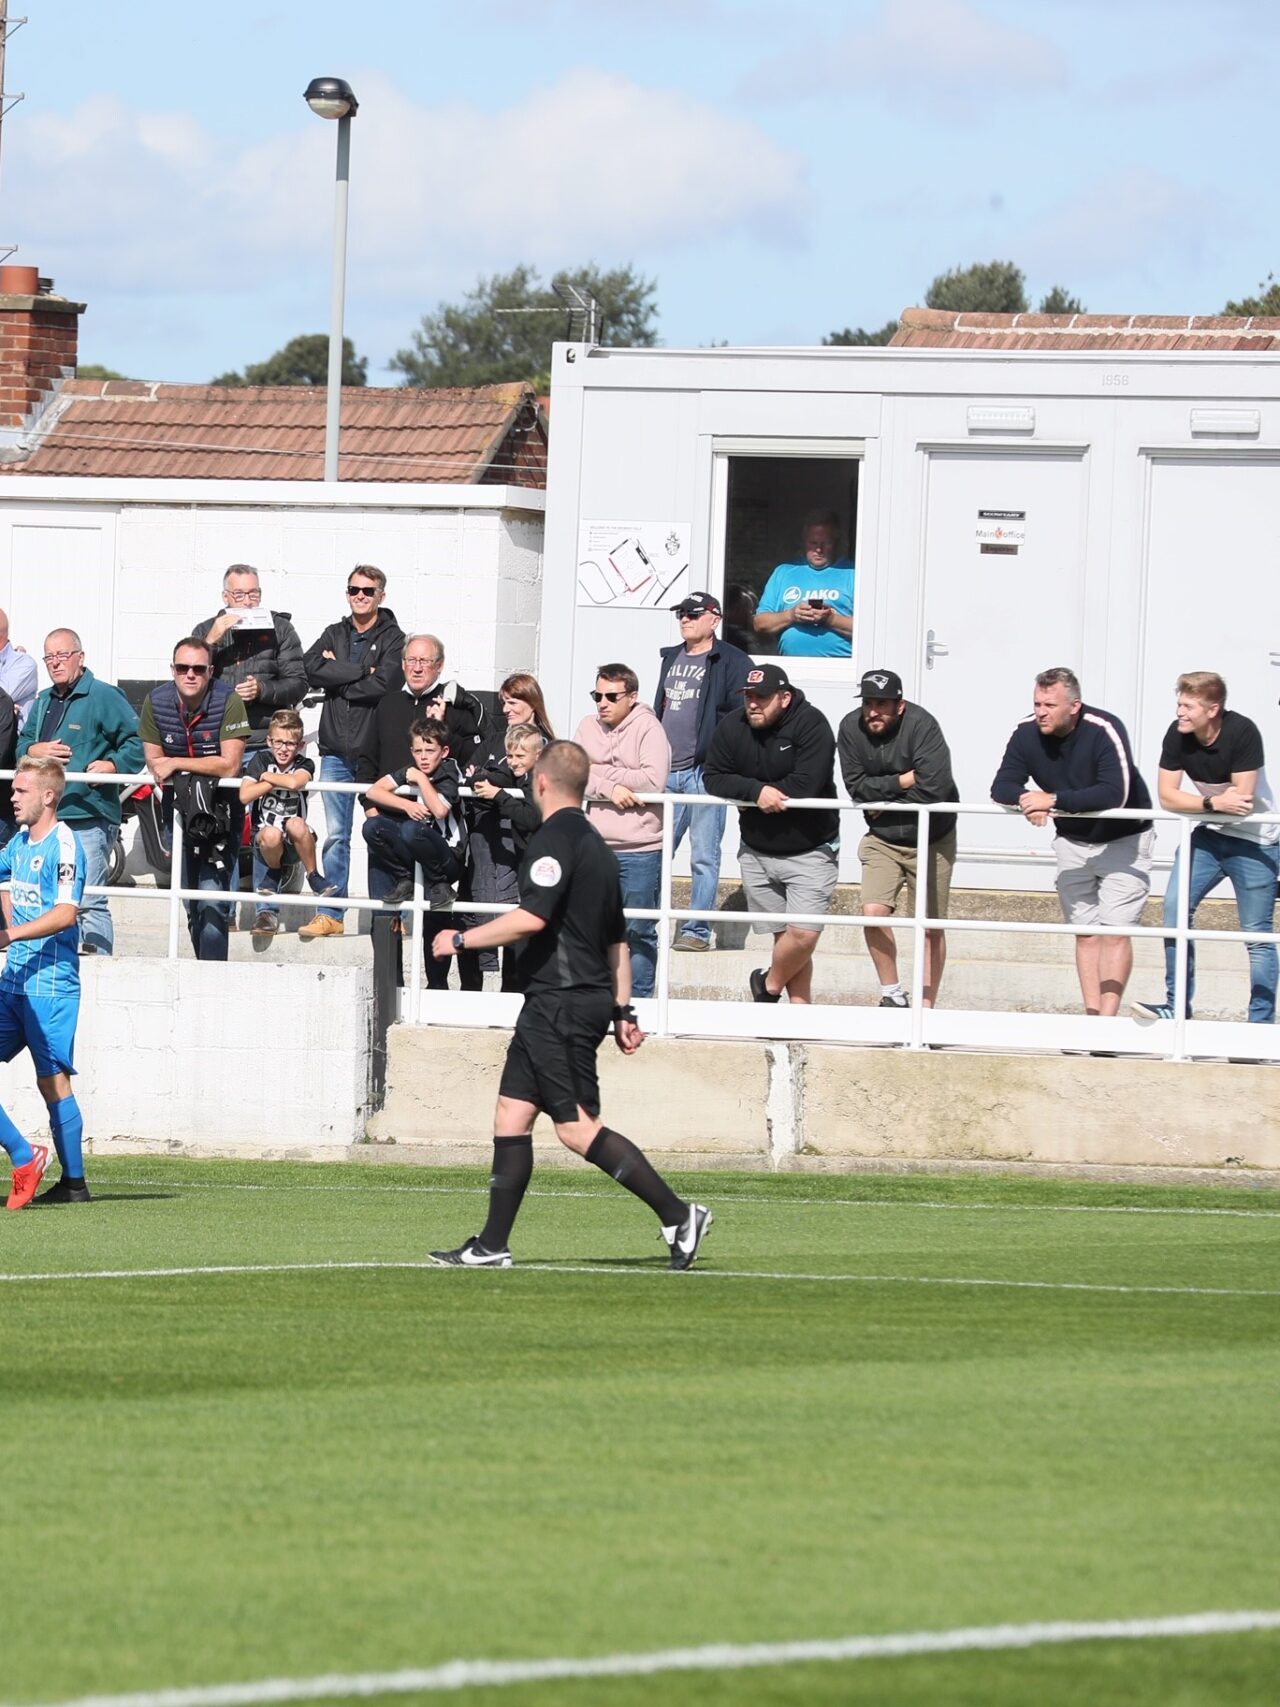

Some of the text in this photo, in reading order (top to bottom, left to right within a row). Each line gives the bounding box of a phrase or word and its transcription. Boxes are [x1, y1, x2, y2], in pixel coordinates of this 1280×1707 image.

[976, 529, 1025, 539] Main office
[802, 589, 840, 601] JAKO
